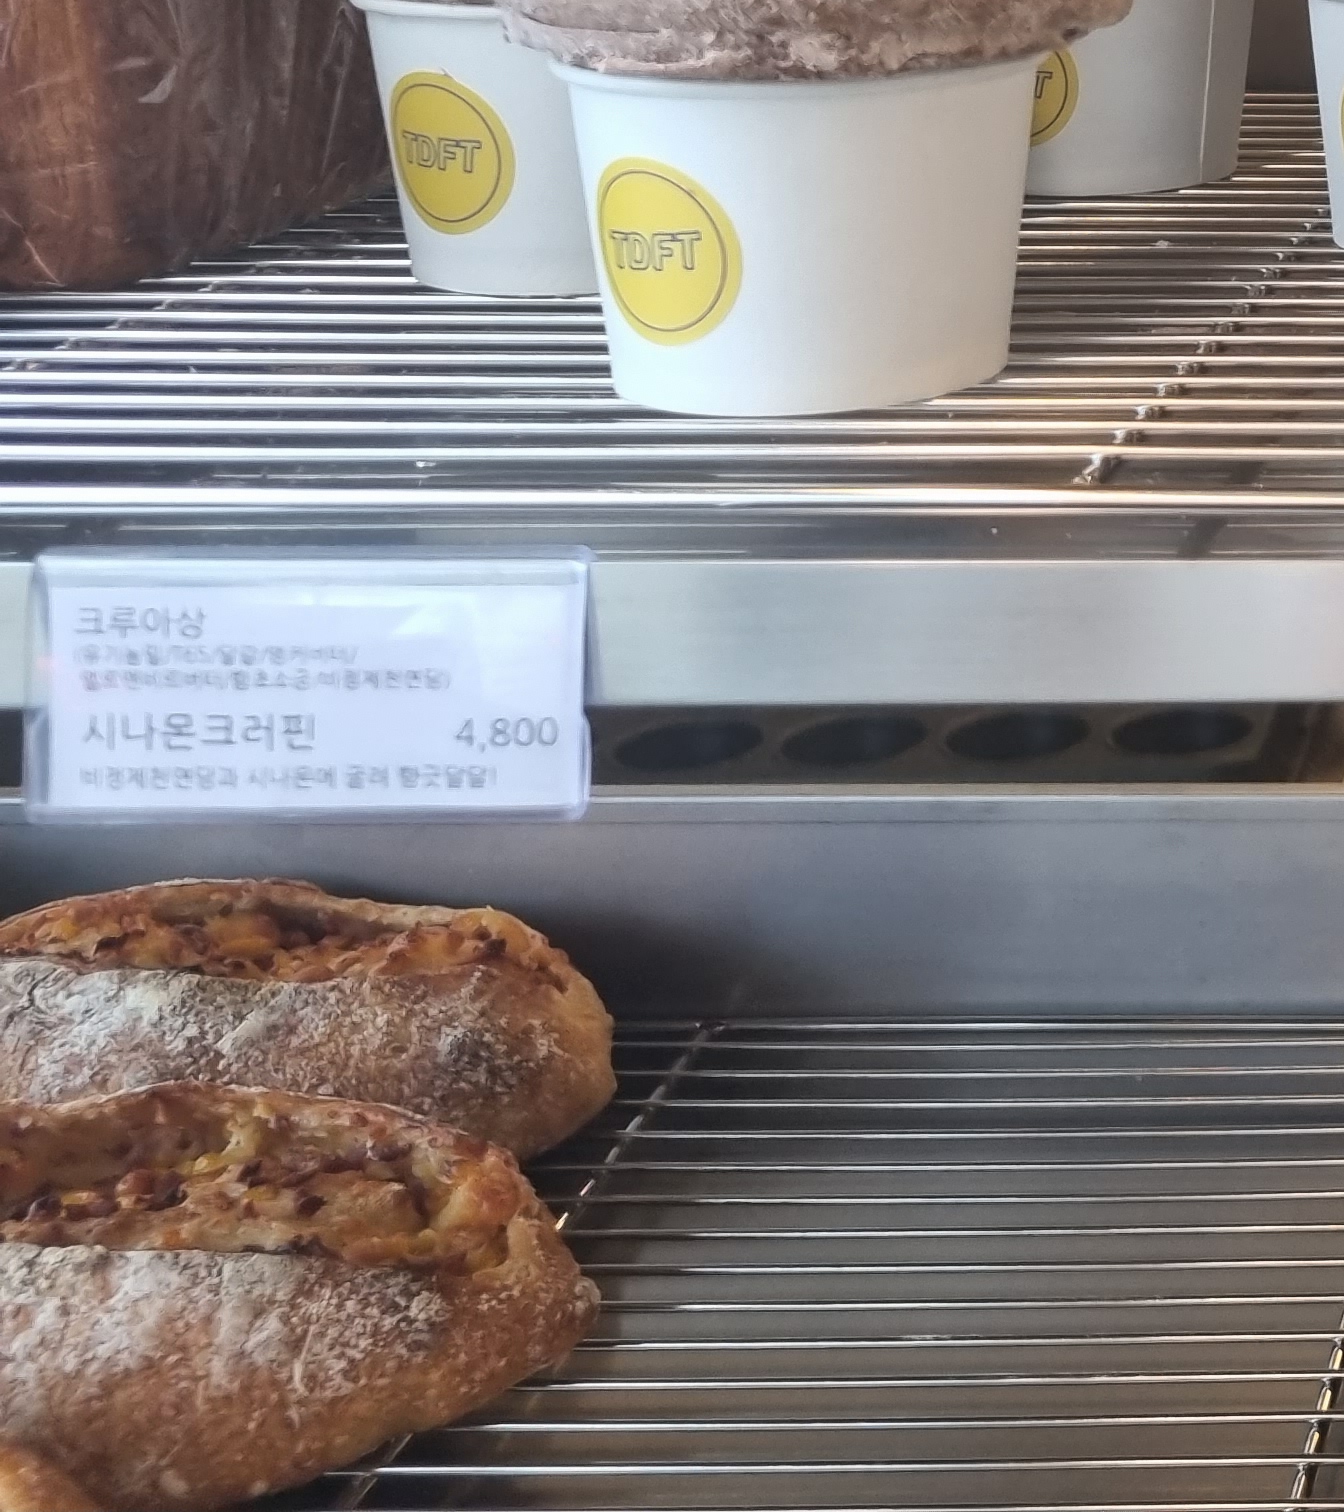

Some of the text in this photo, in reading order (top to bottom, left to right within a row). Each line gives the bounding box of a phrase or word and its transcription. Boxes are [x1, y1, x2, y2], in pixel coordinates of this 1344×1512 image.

[401, 130, 483, 173] TDFT
[608, 228, 703, 273] TDFT
[73, 605, 208, 640] 크루아상
[453, 716, 559, 753] 4,800
